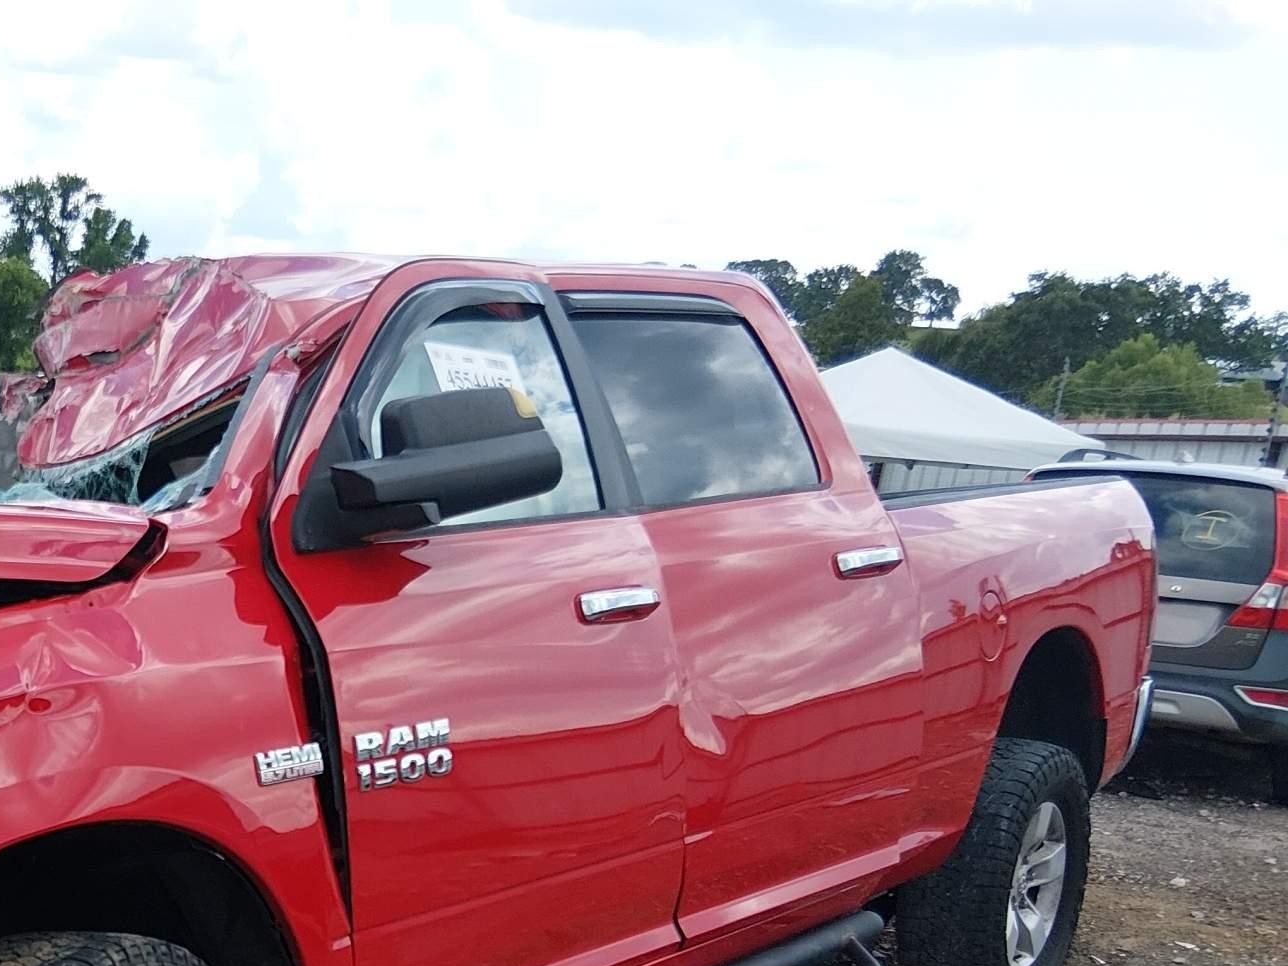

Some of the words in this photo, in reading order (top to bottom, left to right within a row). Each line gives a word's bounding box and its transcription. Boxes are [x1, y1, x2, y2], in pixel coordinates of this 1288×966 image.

[255, 742, 321, 769] HEMI
[354, 718, 451, 761] RAM
[357, 747, 453, 792] 1500
